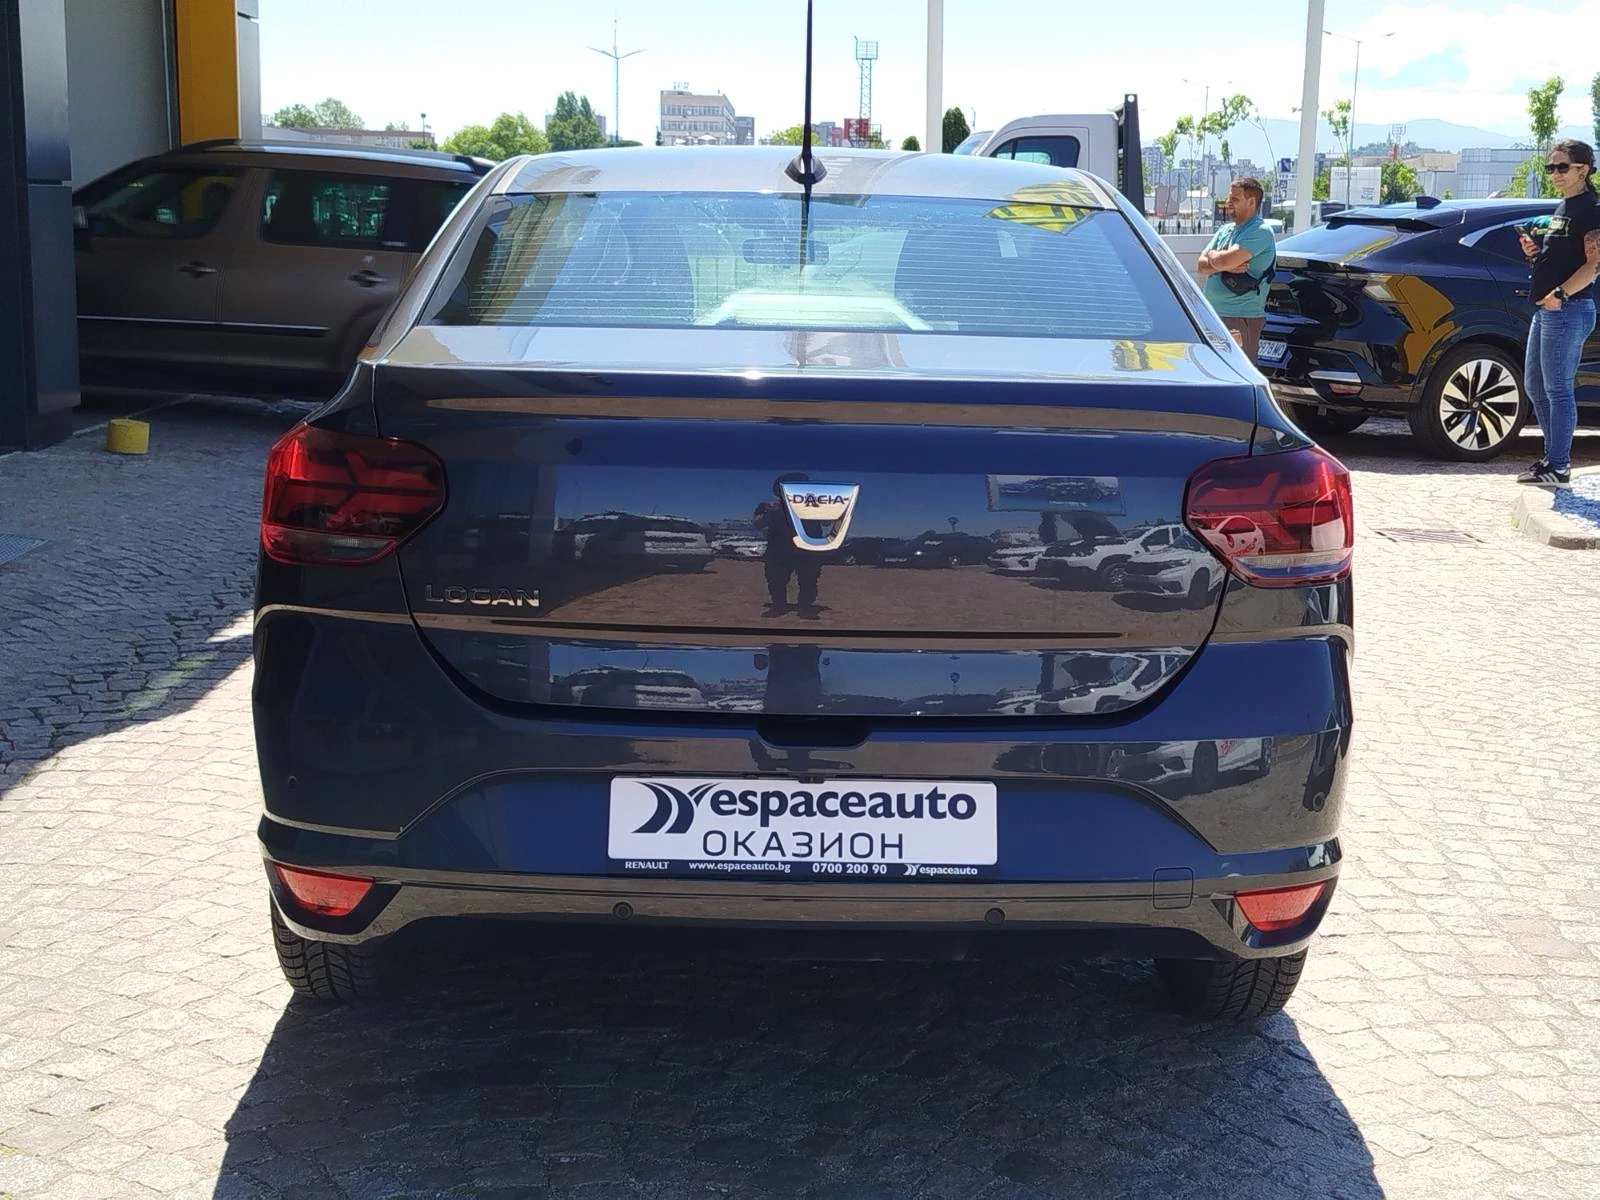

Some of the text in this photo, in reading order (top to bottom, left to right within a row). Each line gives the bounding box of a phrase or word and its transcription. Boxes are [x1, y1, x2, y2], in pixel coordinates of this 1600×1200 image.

[793, 494, 845, 505] DACIA
[425, 584, 540, 607] LOGAN
[709, 786, 977, 827] espaceauto
[702, 830, 904, 860] ОКАЗИОН
[624, 860, 670, 870] RENAULT
[688, 861, 792, 873] www.espaceauto.bg
[812, 862, 888, 875] 0700 200 90
[919, 866, 978, 876] espaceauto
